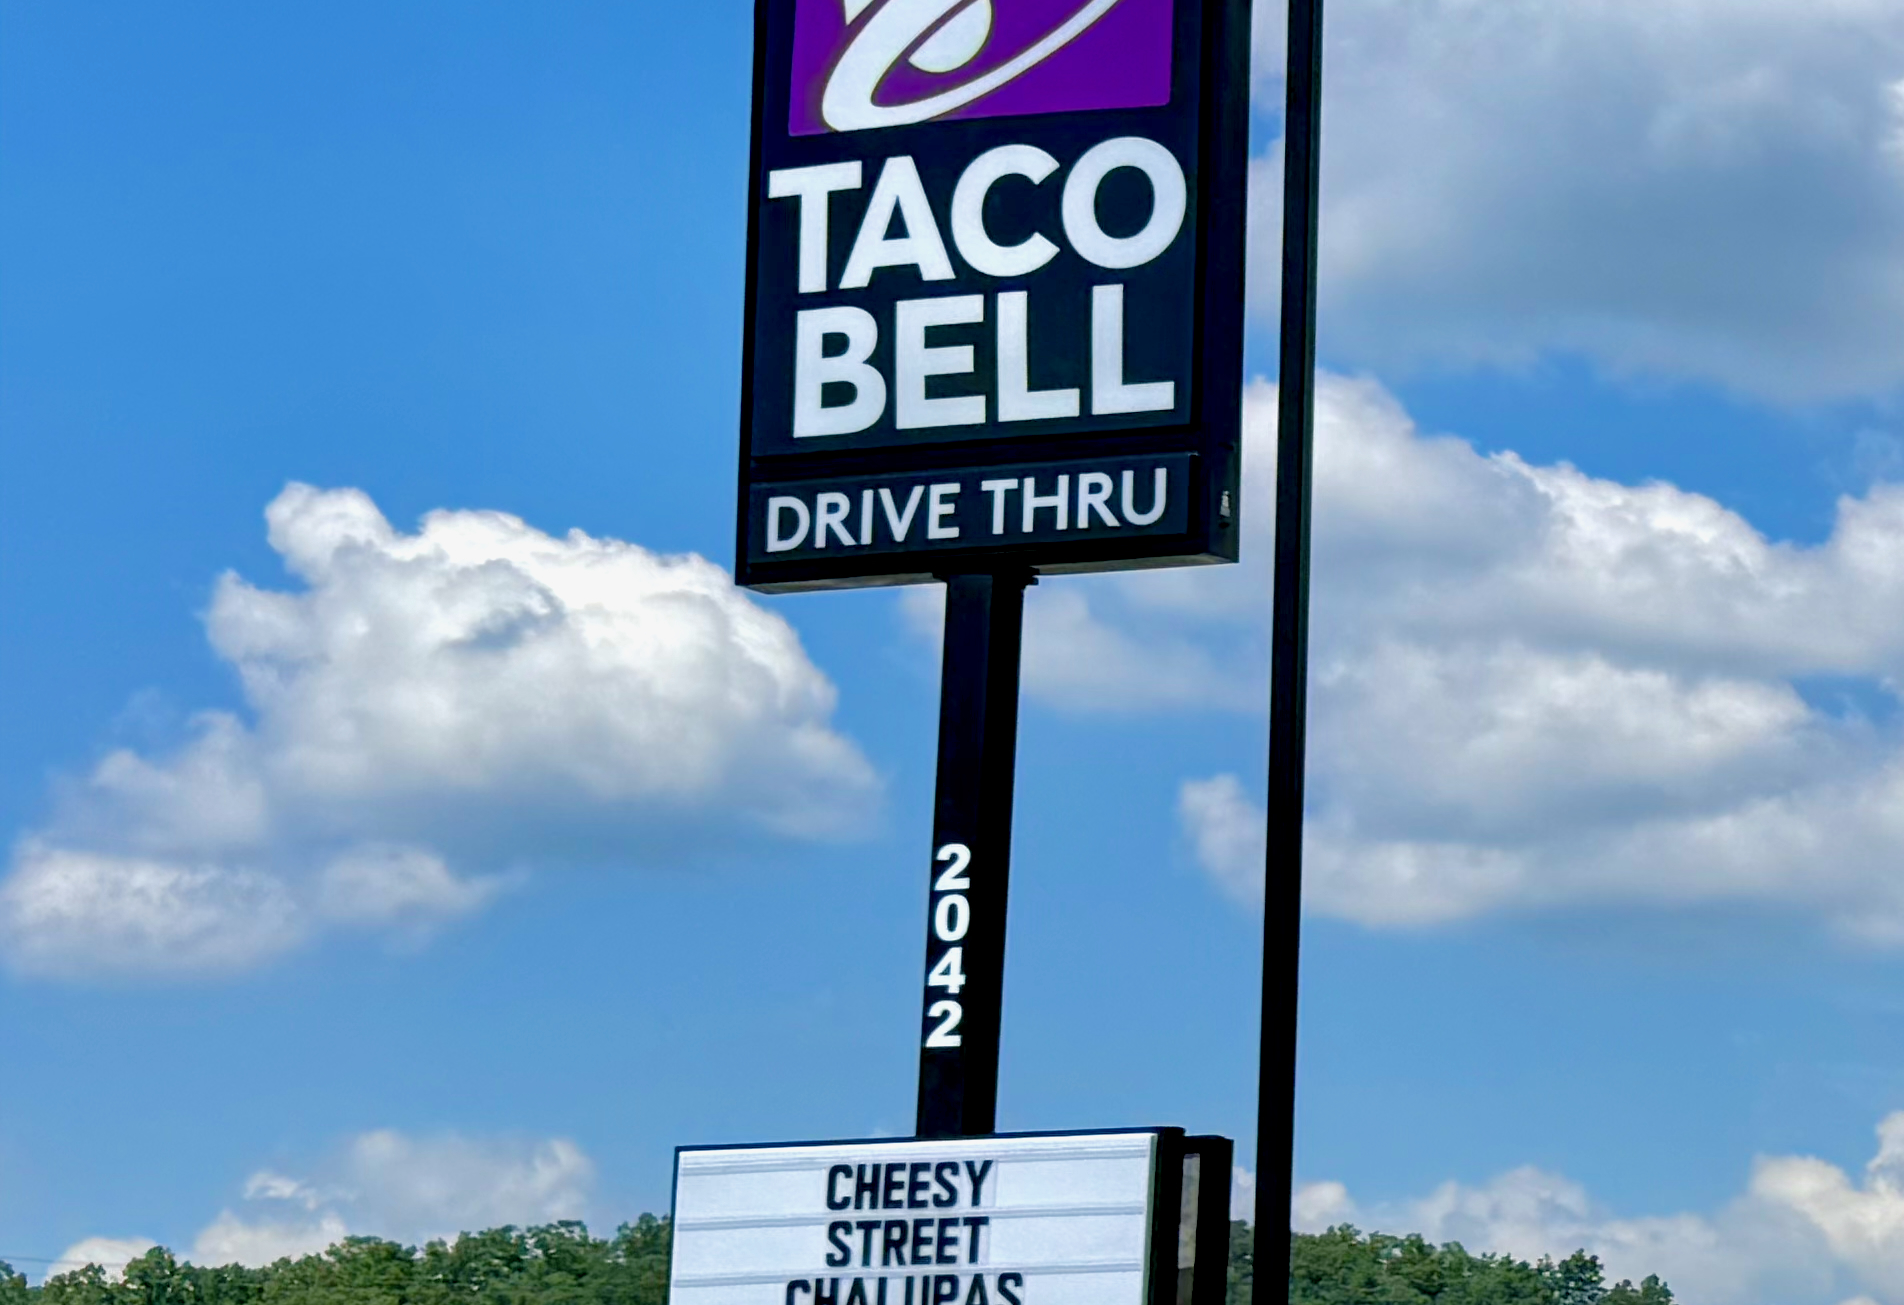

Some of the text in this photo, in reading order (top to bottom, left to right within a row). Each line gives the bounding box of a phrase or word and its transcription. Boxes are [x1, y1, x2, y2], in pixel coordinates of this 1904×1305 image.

[769, 136, 1187, 294] TACO
[793, 284, 1175, 439] BELL
[766, 467, 1168, 553] DRIVE THRU
[925, 843, 971, 1048] 2042
[825, 1216, 989, 1268] STREET
[826, 1159, 993, 1211] CHEESY
